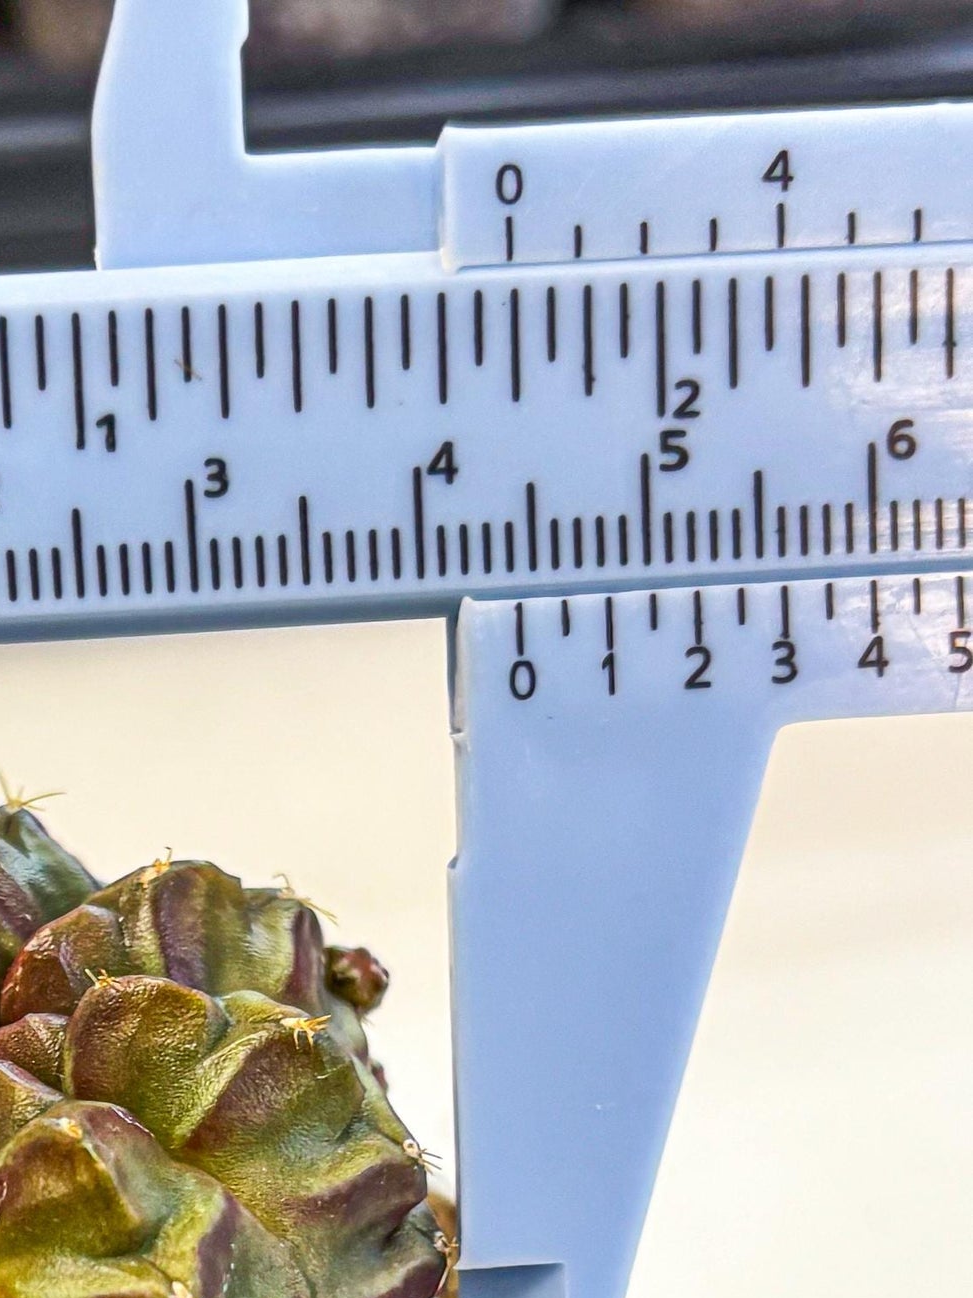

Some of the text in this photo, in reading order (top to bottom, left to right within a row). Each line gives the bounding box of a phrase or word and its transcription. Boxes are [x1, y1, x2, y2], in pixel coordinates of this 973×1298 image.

[495, 149, 794, 205] 0 4
[95, 413, 117, 452] 1
[673, 379, 701, 419] 2
[203, 457, 230, 498] 3
[426, 441, 459, 484] 4
[658, 429, 690, 472] 5
[886, 419, 918, 460] 6
[509, 659, 537, 700] 0
[601, 651, 616, 696] 1
[684, 645, 712, 689] 2
[771, 640, 798, 684] 3
[857, 635, 889, 677] 4
